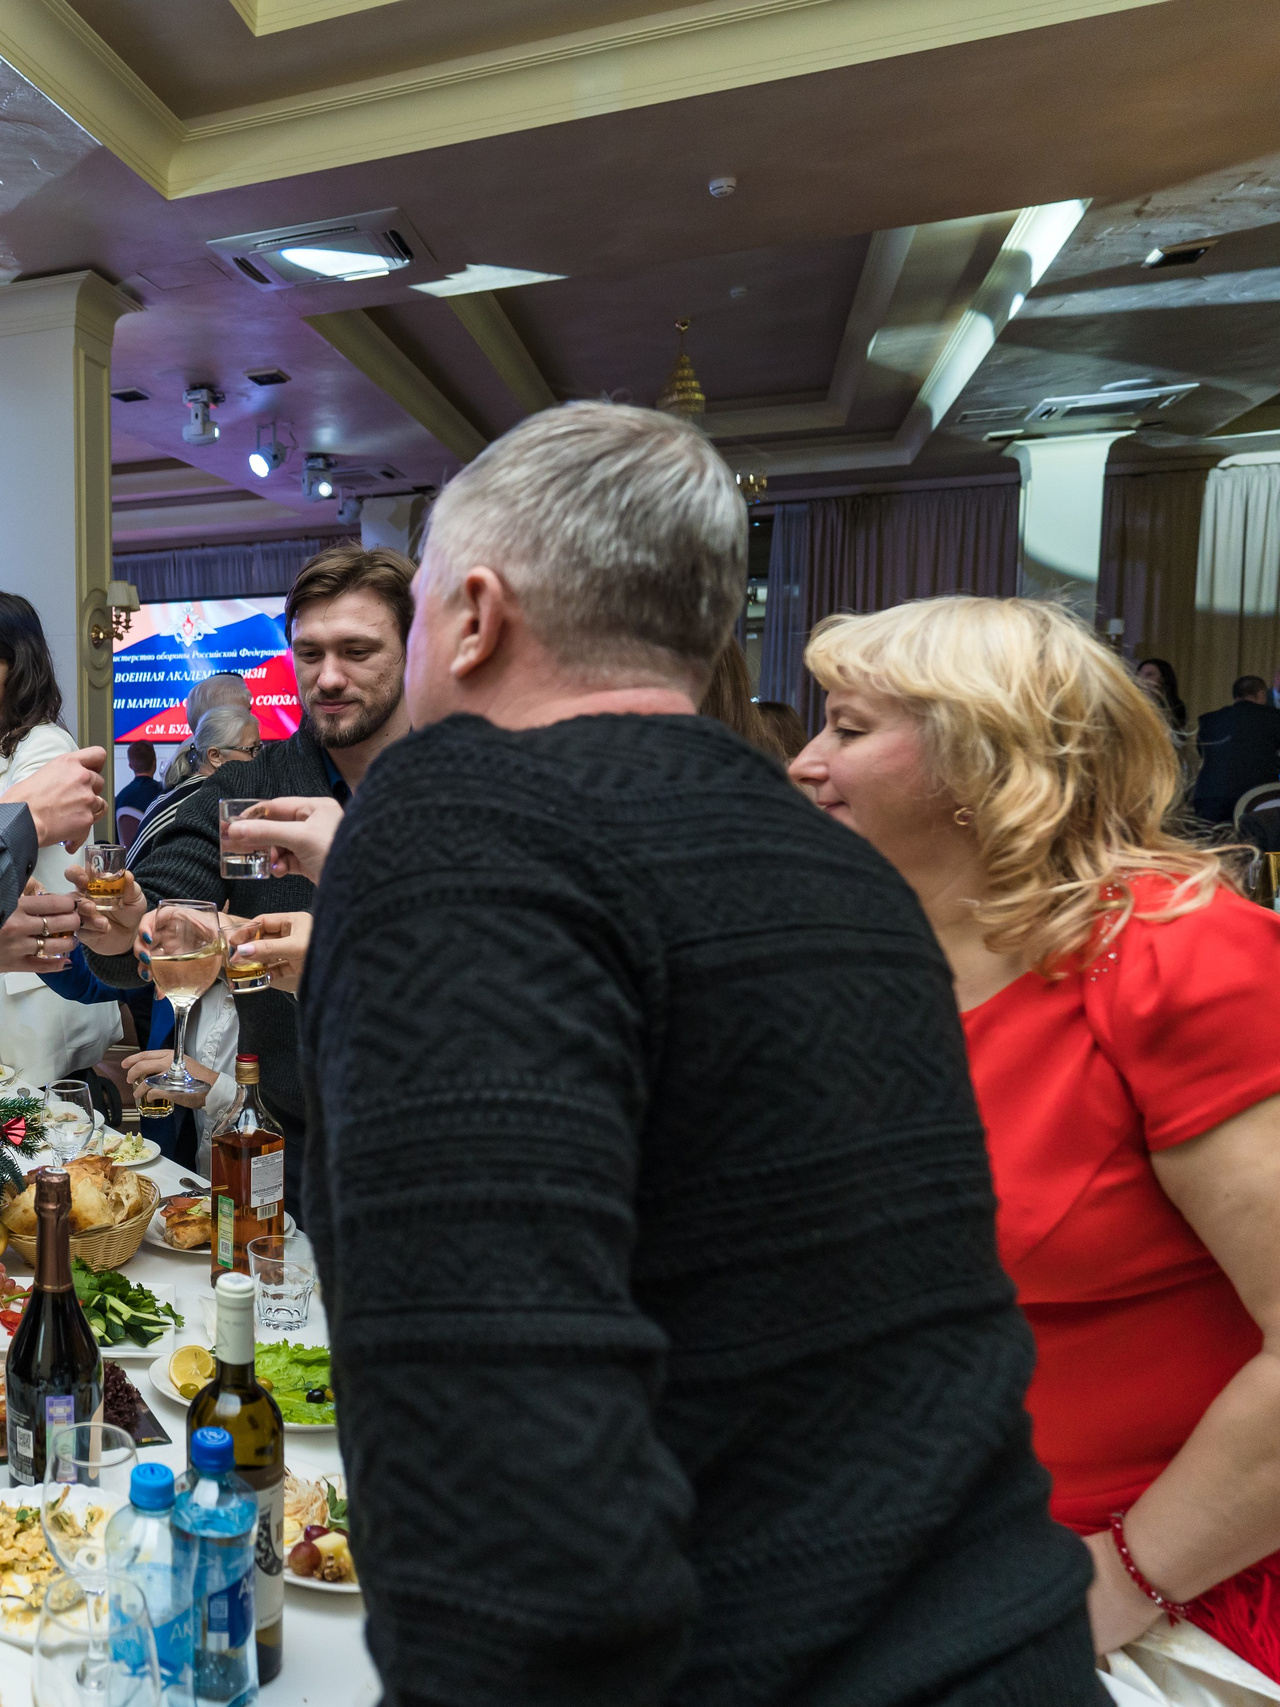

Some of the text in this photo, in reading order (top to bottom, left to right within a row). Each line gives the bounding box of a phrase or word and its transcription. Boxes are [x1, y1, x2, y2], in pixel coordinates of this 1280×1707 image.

[156, 651, 190, 662] обороны
[192, 648, 238, 660] Российской
[239, 647, 287, 658] Федерации
[114, 671, 165, 683] ВОЕННАЯ
[166, 669, 228, 682] АКАДЕМ
[126, 697, 181, 709] МАРШАЛА
[255, 694, 297, 706] СОЮЗА
[145, 723, 167, 735] С.М.
